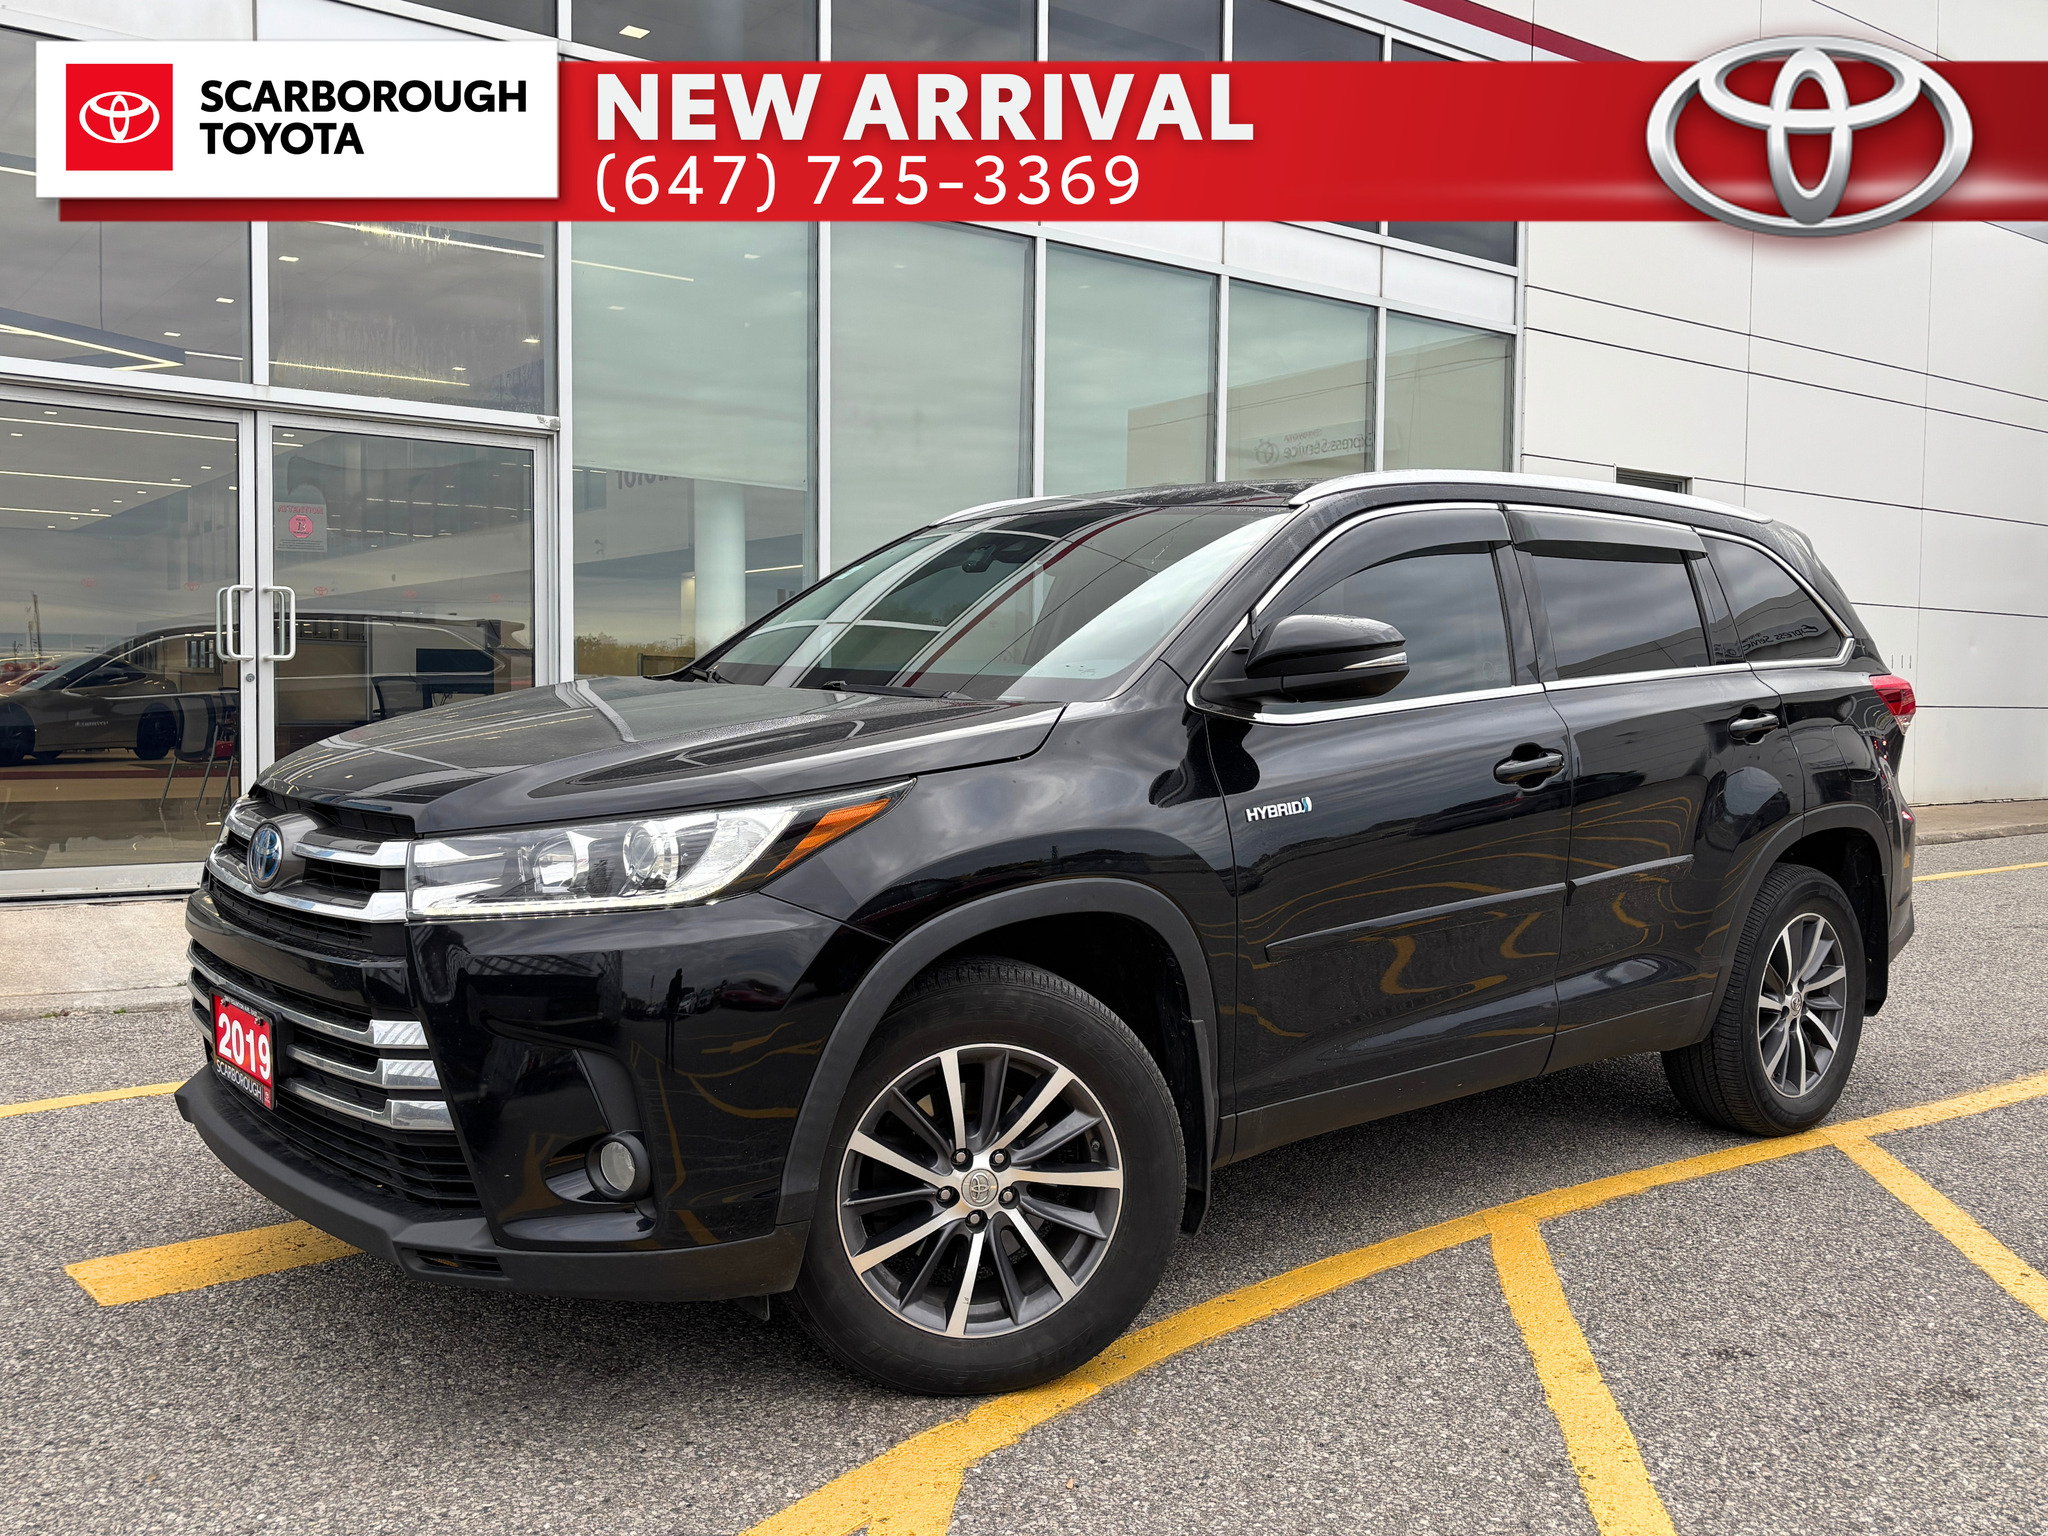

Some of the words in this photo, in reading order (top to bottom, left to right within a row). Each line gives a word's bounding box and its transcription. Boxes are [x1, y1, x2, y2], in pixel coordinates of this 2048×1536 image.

[1245, 800, 1306, 822] HYBRID
[218, 1012, 271, 1080] 2019
[216, 1059, 262, 1102] SCARBOROUGH
